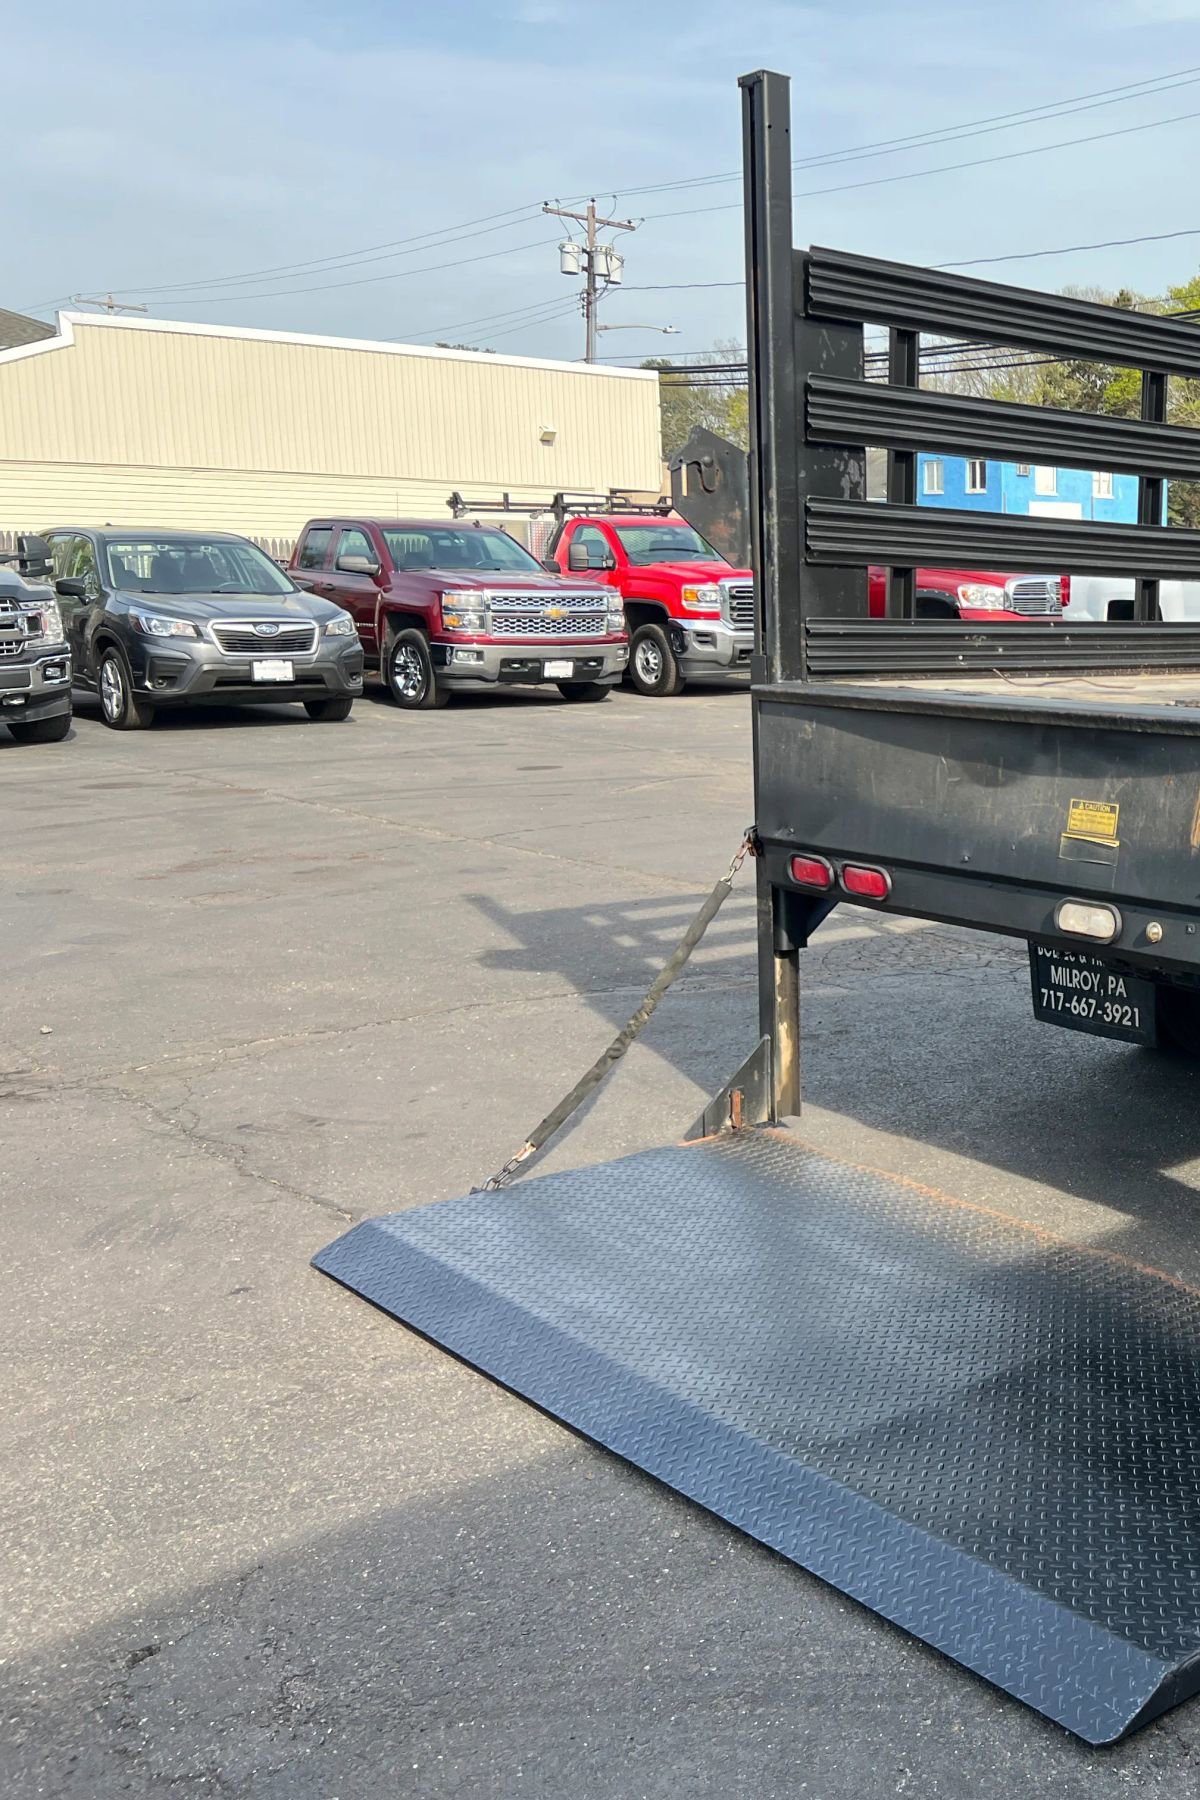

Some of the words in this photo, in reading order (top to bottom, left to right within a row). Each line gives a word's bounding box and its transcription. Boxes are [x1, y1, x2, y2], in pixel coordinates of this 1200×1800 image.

[1085, 803, 1111, 812] CAUTION
[1051, 965, 1104, 997] MILROY,
[1108, 976, 1128, 998] PA
[1040, 988, 1141, 1028] 717-667-3921
